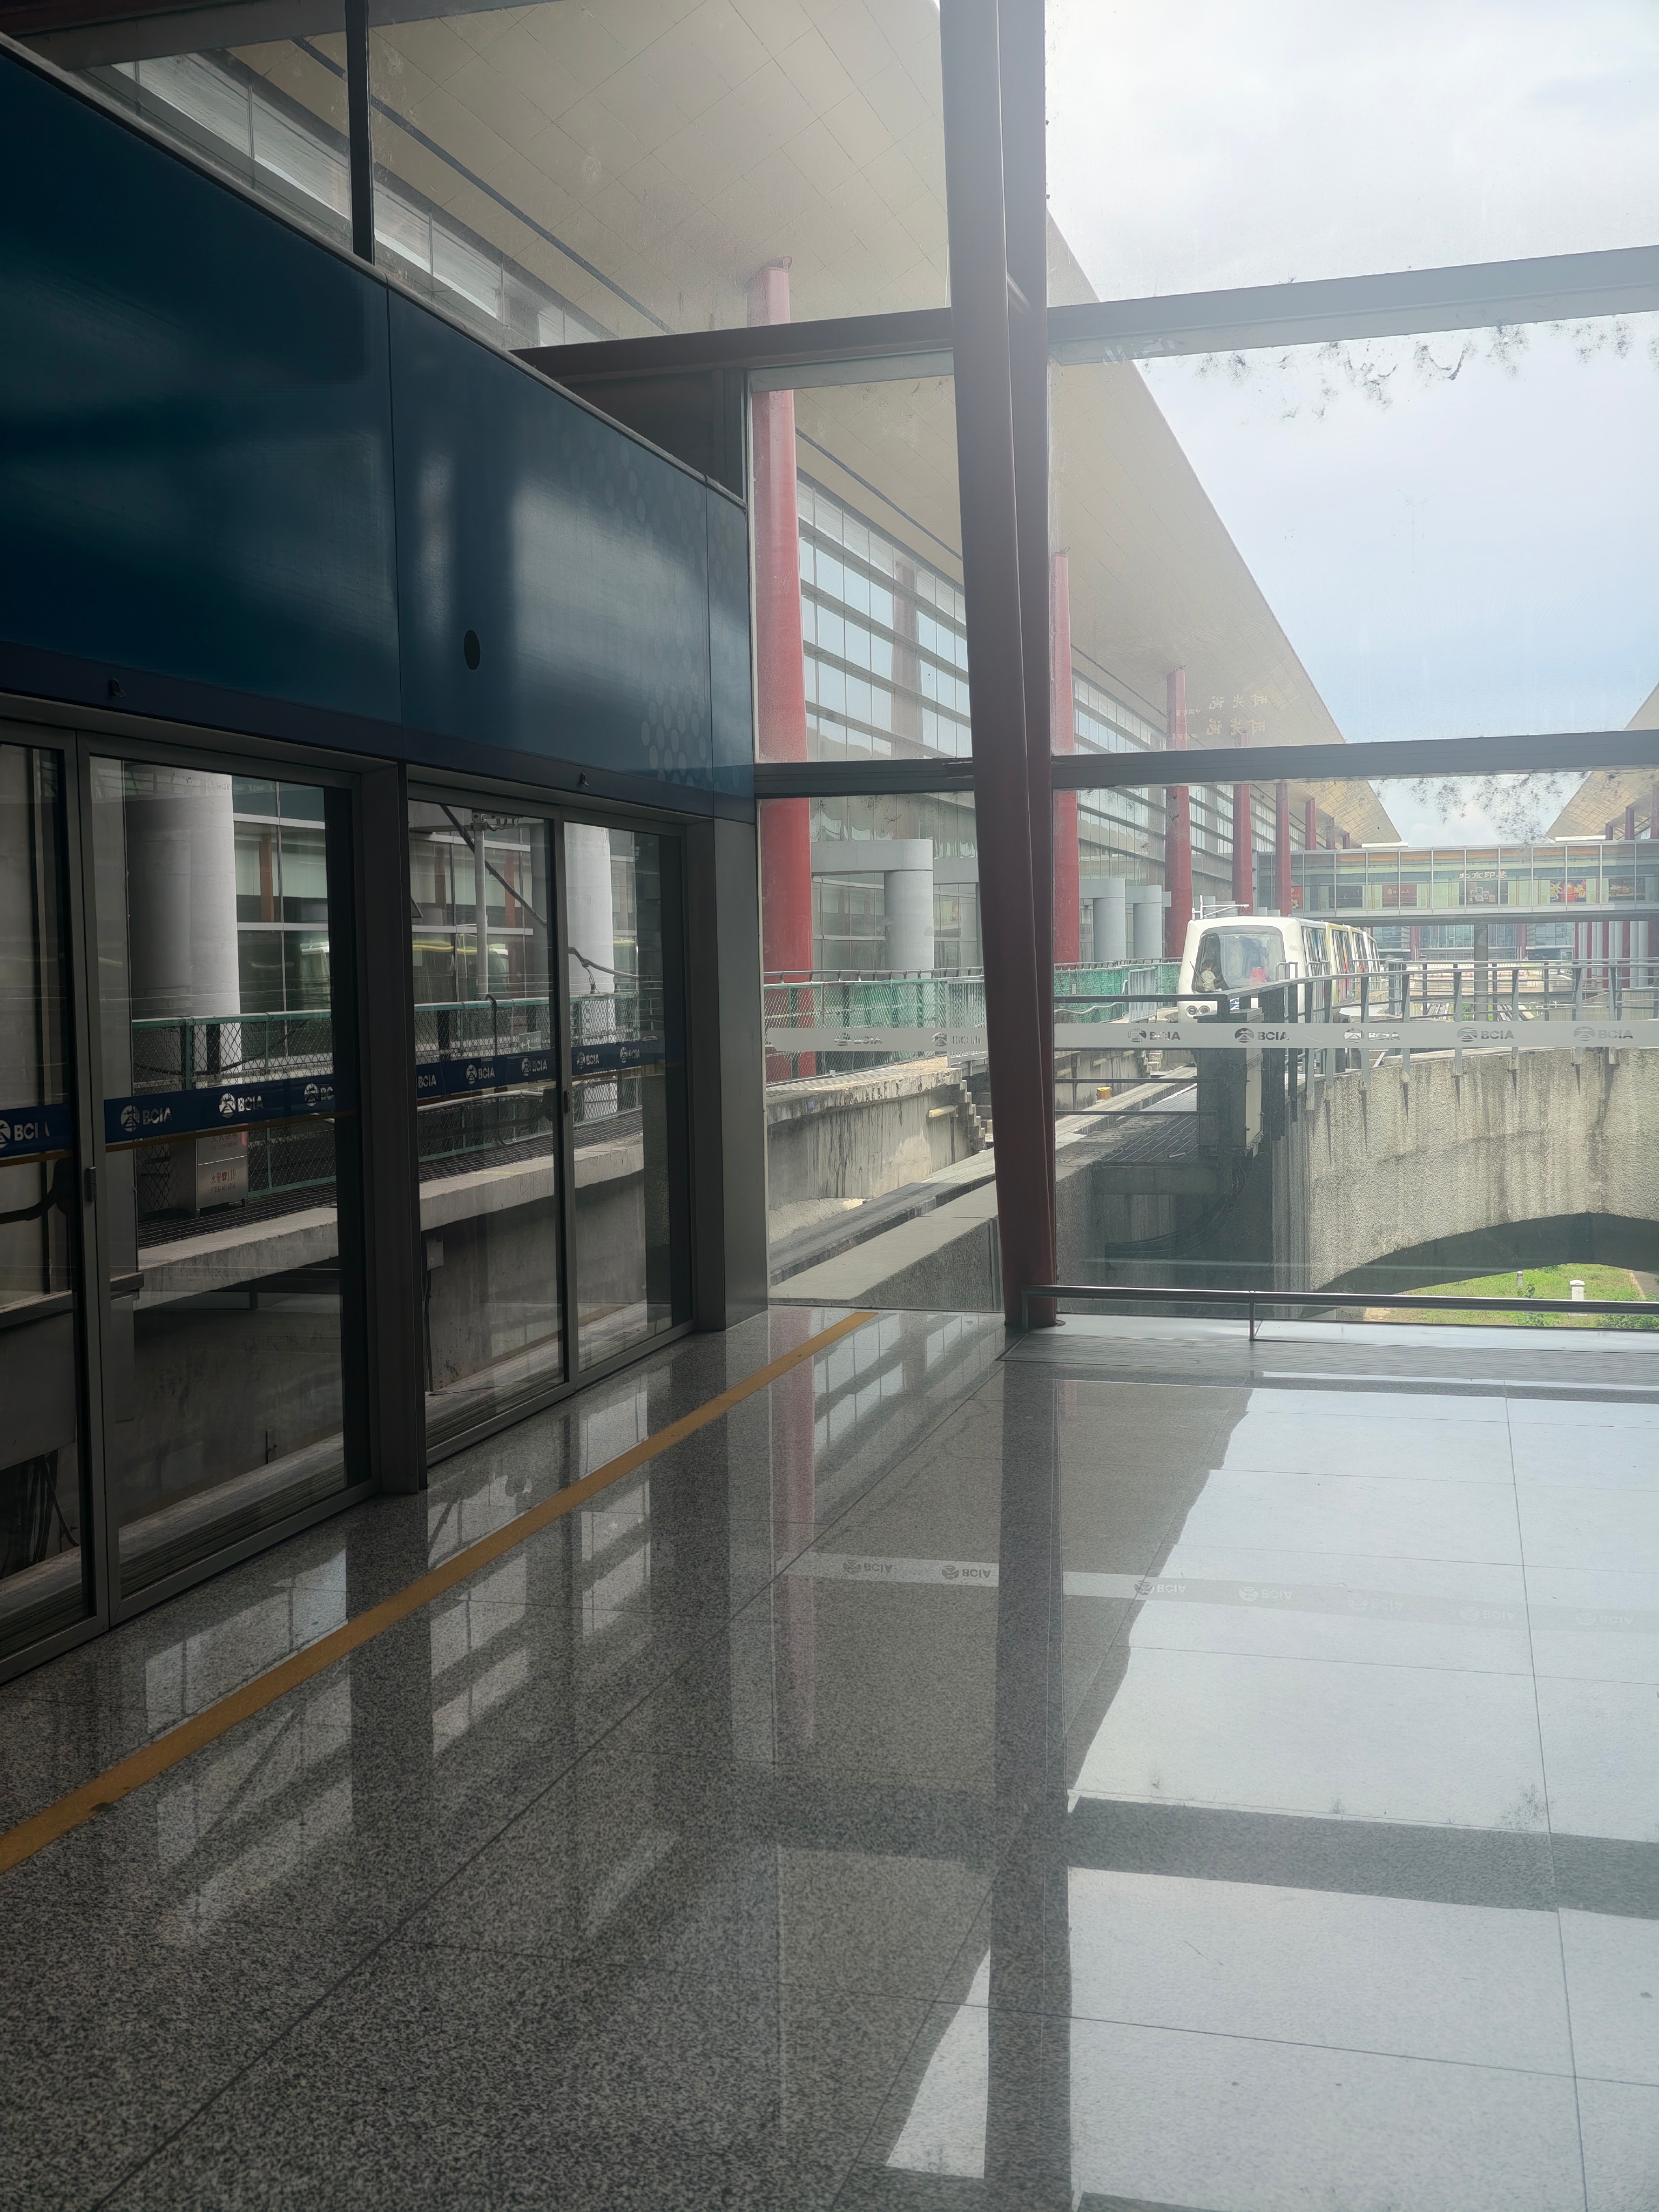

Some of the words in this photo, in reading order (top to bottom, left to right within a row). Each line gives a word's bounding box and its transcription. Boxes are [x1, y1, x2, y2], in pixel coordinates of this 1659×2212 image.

[1149, 1031, 1181, 1041] BCIA
[1257, 1032, 1290, 1041] BCIA
[1368, 1031, 1400, 1041] BCIA
[1481, 1030, 1514, 1040] BCIA
[1598, 1029, 1633, 1039] BCIA
[586, 1054, 599, 1065] BCIA
[628, 1049, 640, 1059] BCIA
[532, 1060, 547, 1072] BCIA
[478, 1066, 495, 1080] BCIA
[418, 1074, 437, 1088] BCIA
[237, 1095, 264, 1112] BCIA
[143, 1107, 171, 1125] BCIA
[227, 1168, 236, 1181] 119
